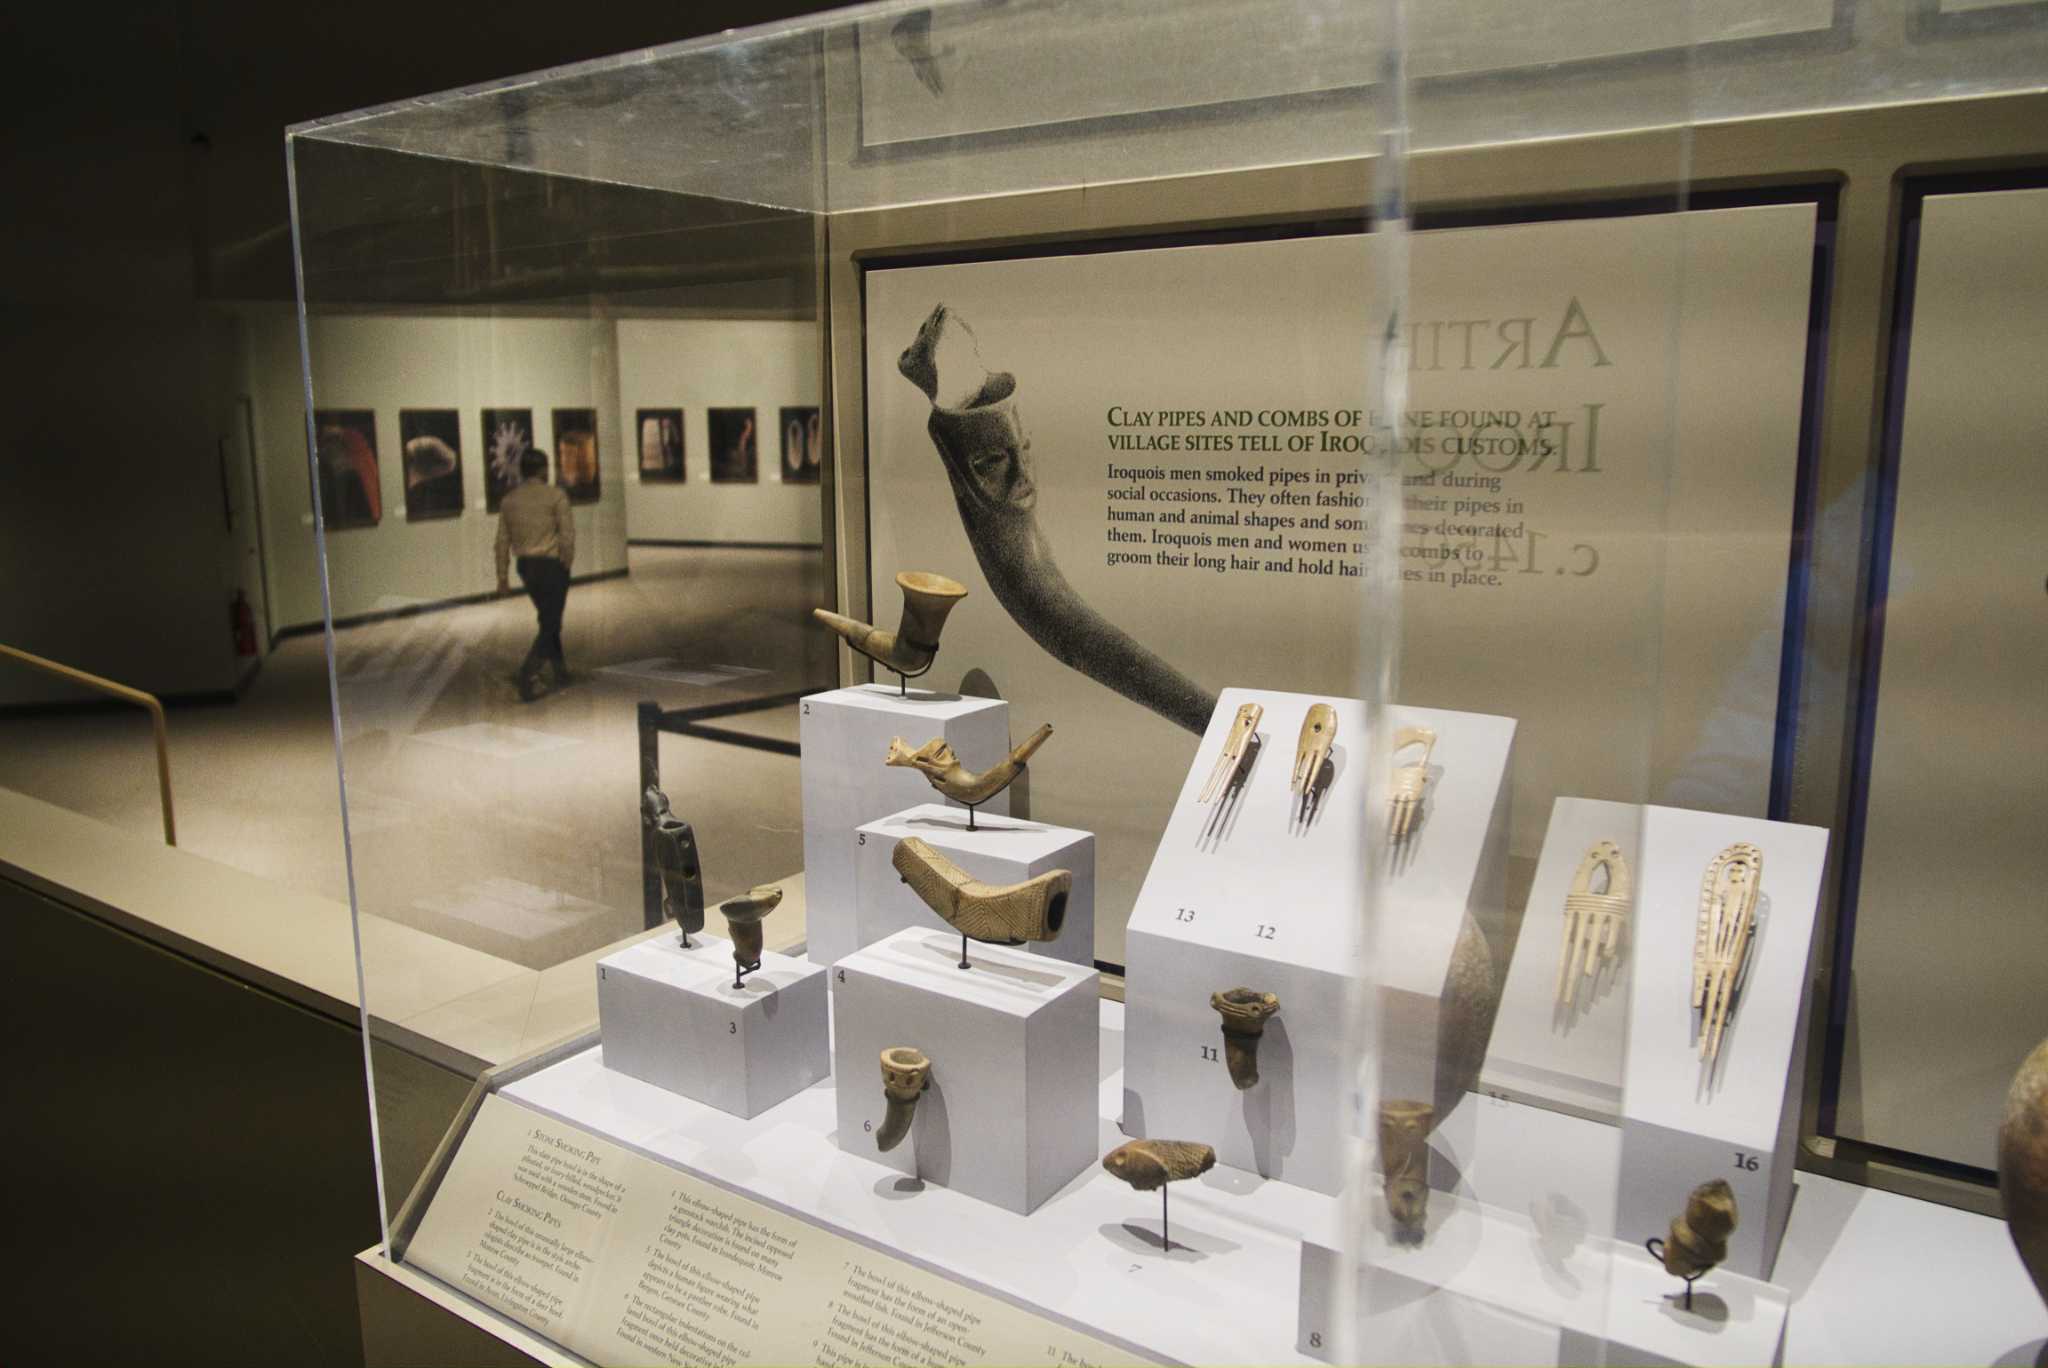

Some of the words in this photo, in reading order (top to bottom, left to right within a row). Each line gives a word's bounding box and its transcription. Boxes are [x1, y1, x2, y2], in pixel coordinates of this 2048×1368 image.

[1107, 406, 1154, 428] CLAY
[1158, 410, 1205, 427] PIPES
[1211, 410, 1253, 427] AND
[1258, 410, 1329, 428] COMBS
[1334, 410, 1362, 428] OF
[1368, 410, 1433, 429] BNE
[1108, 433, 1181, 452] VILLAGE
[1185, 434, 1233, 452] SITES
[1238, 434, 1283, 453] TELL
[1288, 435, 1315, 453] OF
[1320, 430, 1436, 456] IROQOIS
[1107, 464, 1165, 483] Iroquois
[1170, 468, 1201, 481] men
[1206, 466, 1264, 482] smoked
[1270, 467, 1310, 487] pipes
[1316, 468, 1331, 484] in
[1336, 470, 1391, 489] priv
[1107, 487, 1145, 502] social
[1149, 488, 1221, 504] occasions.
[1227, 488, 1265, 508] They
[1270, 490, 1311, 506] often
[1316, 491, 1391, 509] fashio
[1107, 507, 1155, 524] human
[1160, 509, 1186, 525] and
[1190, 509, 1239, 526] animal
[1244, 511, 1295, 533] shapes
[1301, 512, 1329, 529] and
[1335, 516, 1431, 534] somes
[1107, 528, 1147, 543] them.
[1152, 530, 1212, 549] Iroquois
[1217, 535, 1249, 548] men
[1254, 534, 1283, 550] and
[1288, 538, 1347, 553] women
[1107, 552, 1151, 569] groom
[1156, 552, 1189, 568] their
[1194, 553, 1226, 574] long
[1231, 555, 1260, 572] hair
[1264, 557, 1293, 573] and
[1298, 558, 1334, 576] hold
[803, 703, 811, 716] 2
[858, 833, 866, 846] 5
[1176, 908, 1195, 923] 13
[1256, 924, 1276, 940] 12
[600, 967, 607, 981] 1
[837, 969, 846, 984] 4
[729, 1021, 737, 1035] 3
[1201, 1045, 1218, 1063] 11
[863, 1119, 872, 1133] 6
[1735, 1152, 1760, 1172] 16
[1128, 1263, 1143, 1273] 7
[1309, 1332, 1322, 1348] 8
